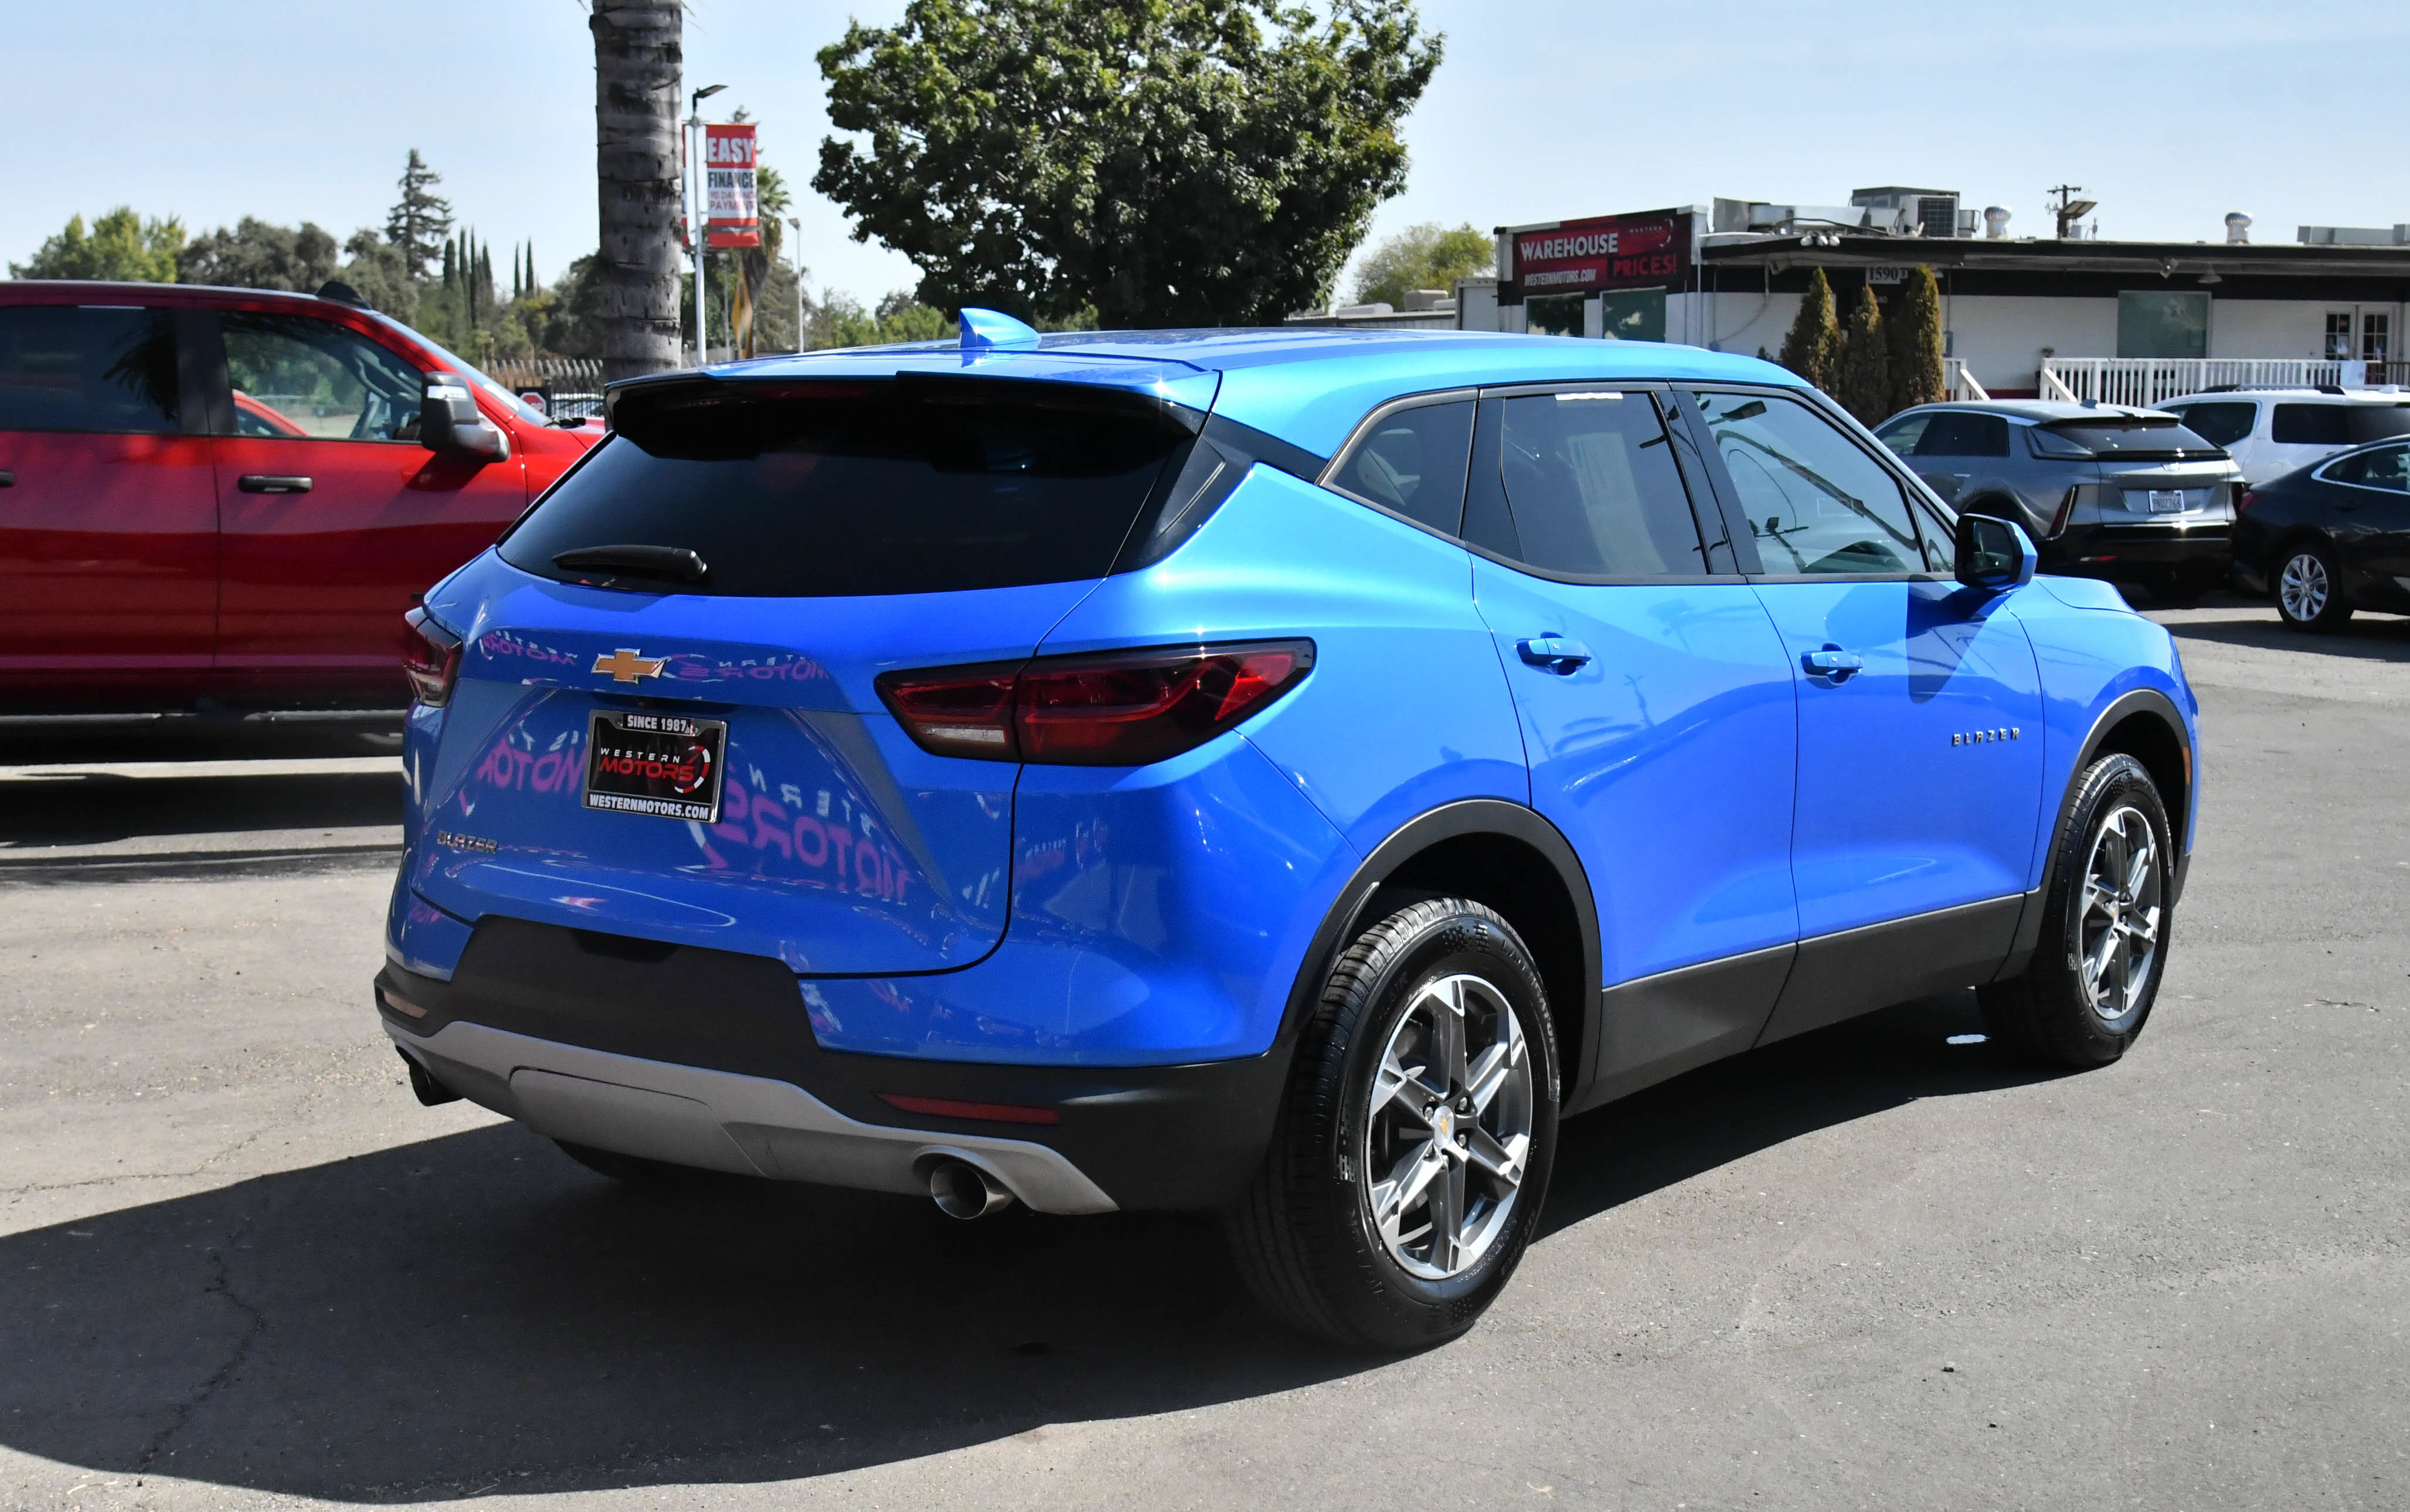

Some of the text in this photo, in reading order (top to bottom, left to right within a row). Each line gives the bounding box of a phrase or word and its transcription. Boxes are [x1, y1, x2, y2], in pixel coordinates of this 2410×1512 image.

[707, 137, 754, 163] EASY
[708, 171, 754, 188] FINANCE
[1520, 233, 1619, 261] WAREHOUSE
[1613, 254, 1677, 277] PRICES!
[1869, 267, 1898, 280] 1590
[1524, 269, 1596, 287] WESTERNMOTORS.COM
[627, 715, 686, 731] SINCE 1987
[1952, 728, 2020, 746] BLAZER
[600, 747, 681, 763] WESTERN
[600, 756, 694, 782] MOTORS
[589, 794, 709, 819] WESTERNMOTORS.COM
[437, 830, 497, 854] BLAZER
